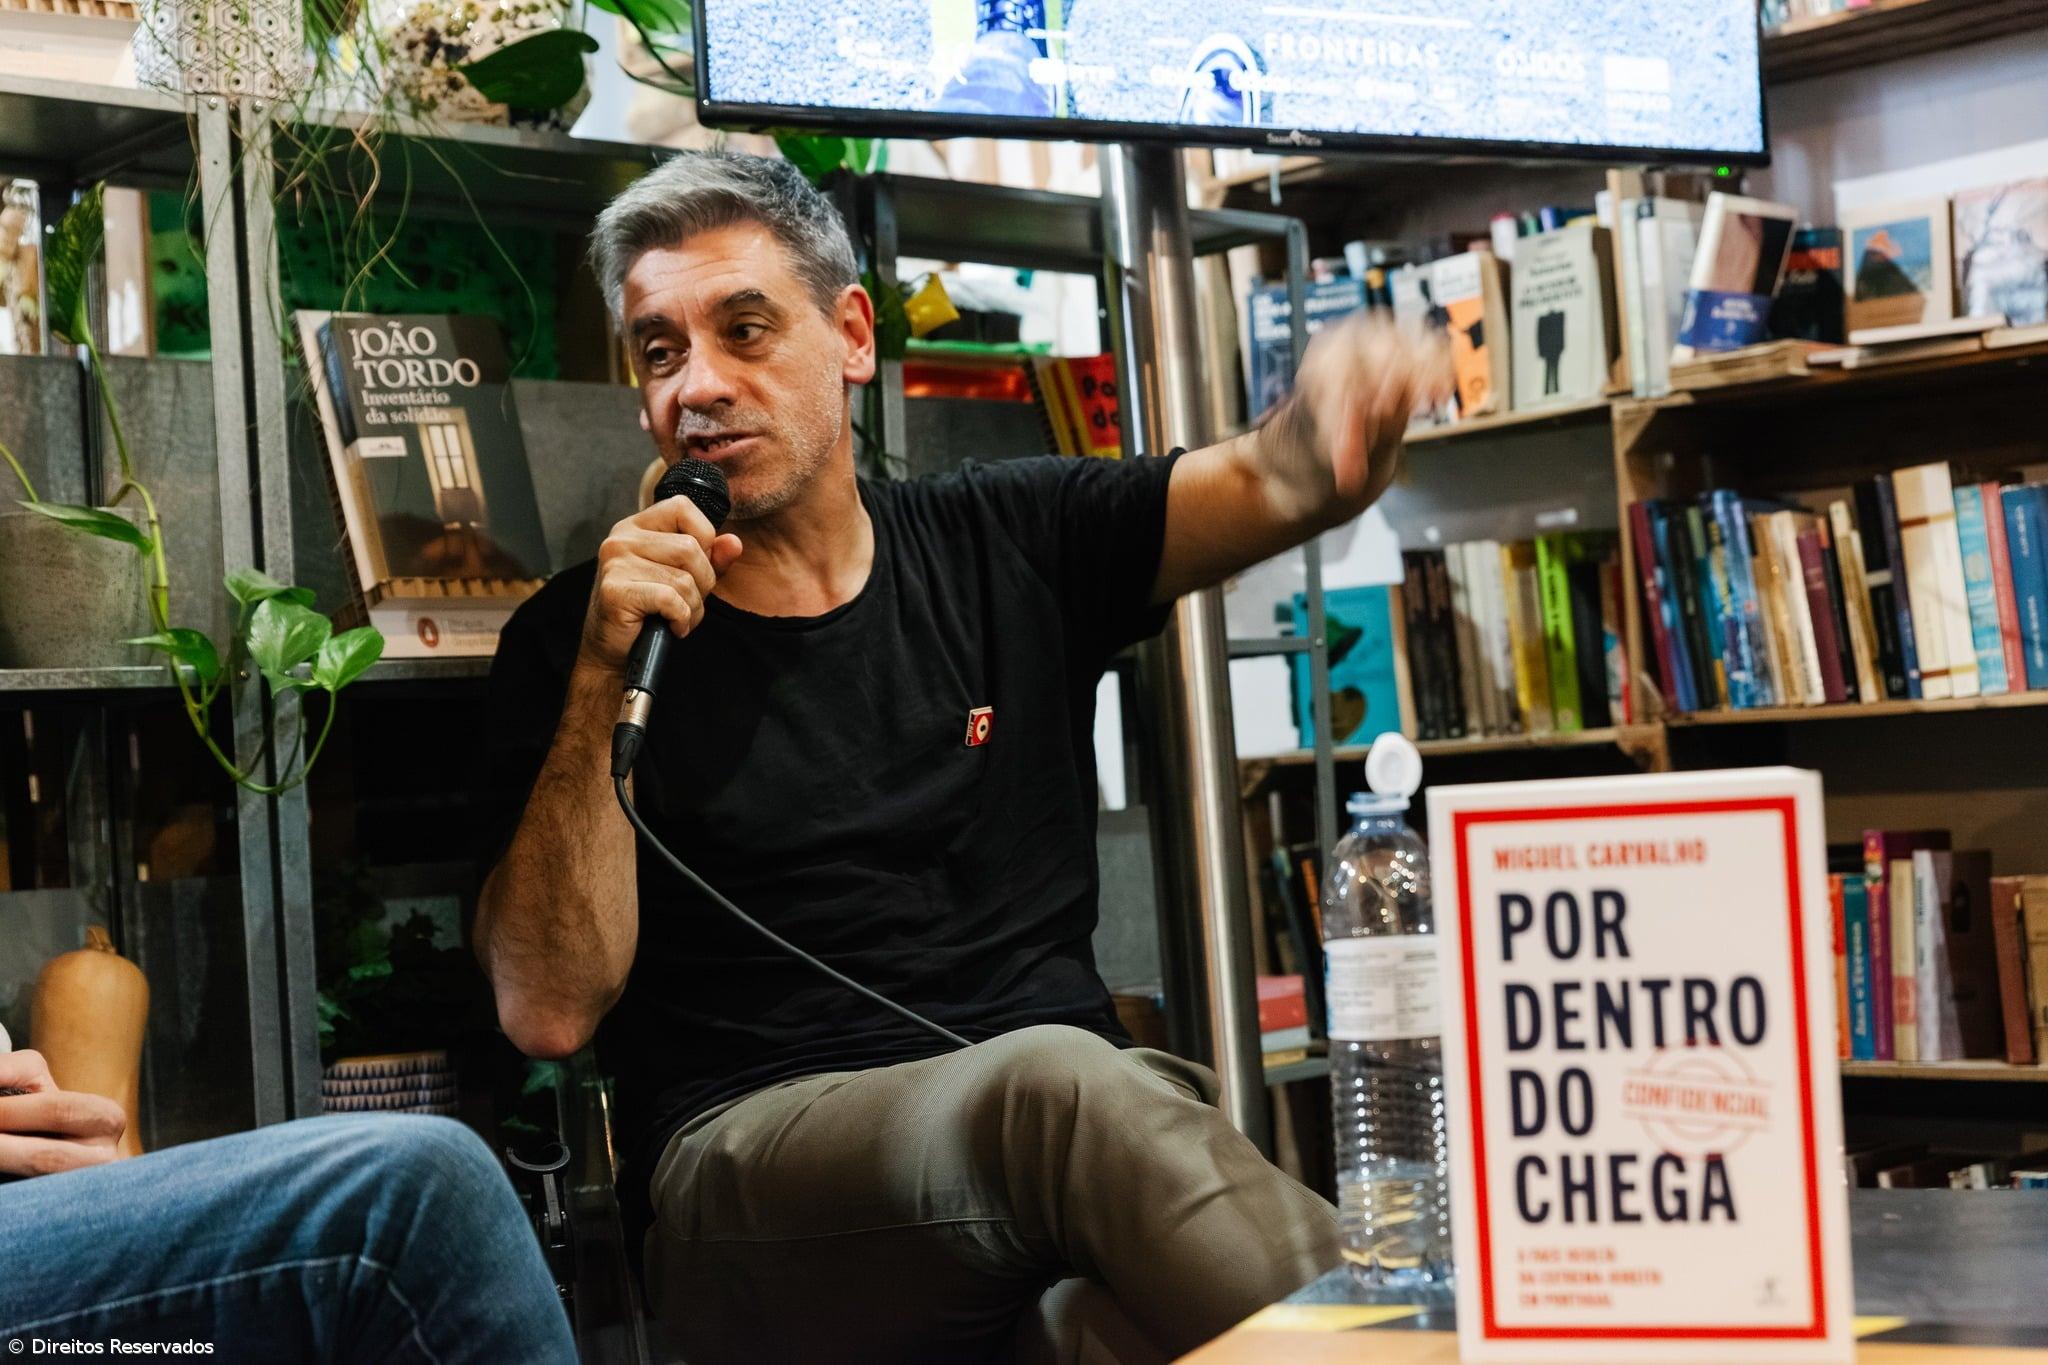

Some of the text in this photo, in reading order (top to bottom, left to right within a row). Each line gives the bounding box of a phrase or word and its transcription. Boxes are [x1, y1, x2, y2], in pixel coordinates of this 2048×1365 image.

[1265, 33, 1441, 69] FRONTEIRAS
[348, 320, 437, 360] JOÃO
[353, 358, 480, 388] TORDO
[361, 388, 450, 406] Inventário
[365, 407, 388, 424] da
[1494, 840, 1706, 871] MIGUEL CARVALHO
[1499, 889, 1630, 961] POR
[1505, 976, 1766, 1051] DENTRO
[1509, 1067, 1594, 1137] DO
[1622, 1079, 1769, 1119] CONFIDENCIAL
[1516, 1153, 1737, 1223] CHEGA
